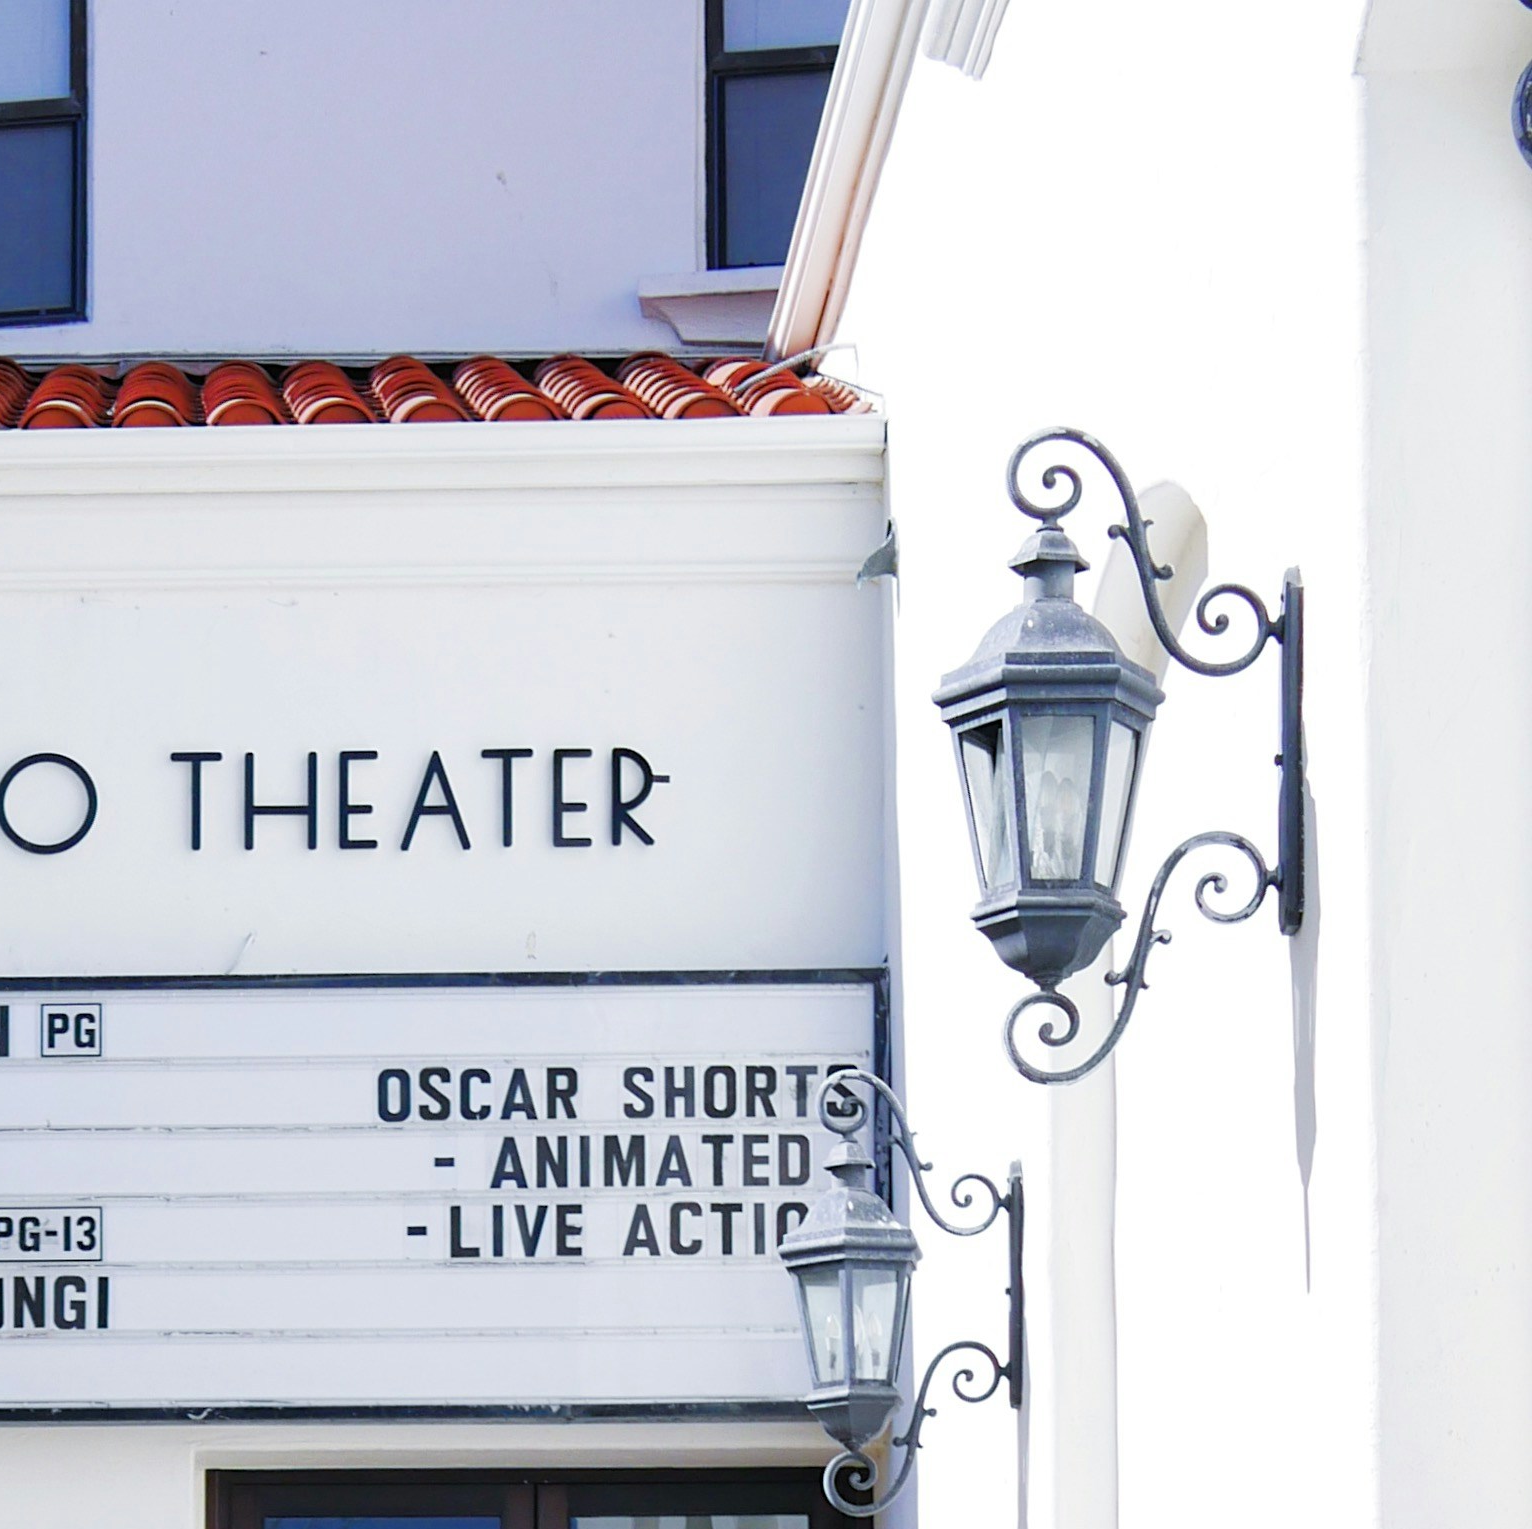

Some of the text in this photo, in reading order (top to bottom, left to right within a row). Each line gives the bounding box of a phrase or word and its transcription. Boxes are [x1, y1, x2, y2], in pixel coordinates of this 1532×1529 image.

[170, 747, 670, 852] THEATER
[47, 1012, 96, 1049] PG
[377, 1067, 578, 1123] OSCAR
[490, 1134, 810, 1188] ANIMATED
